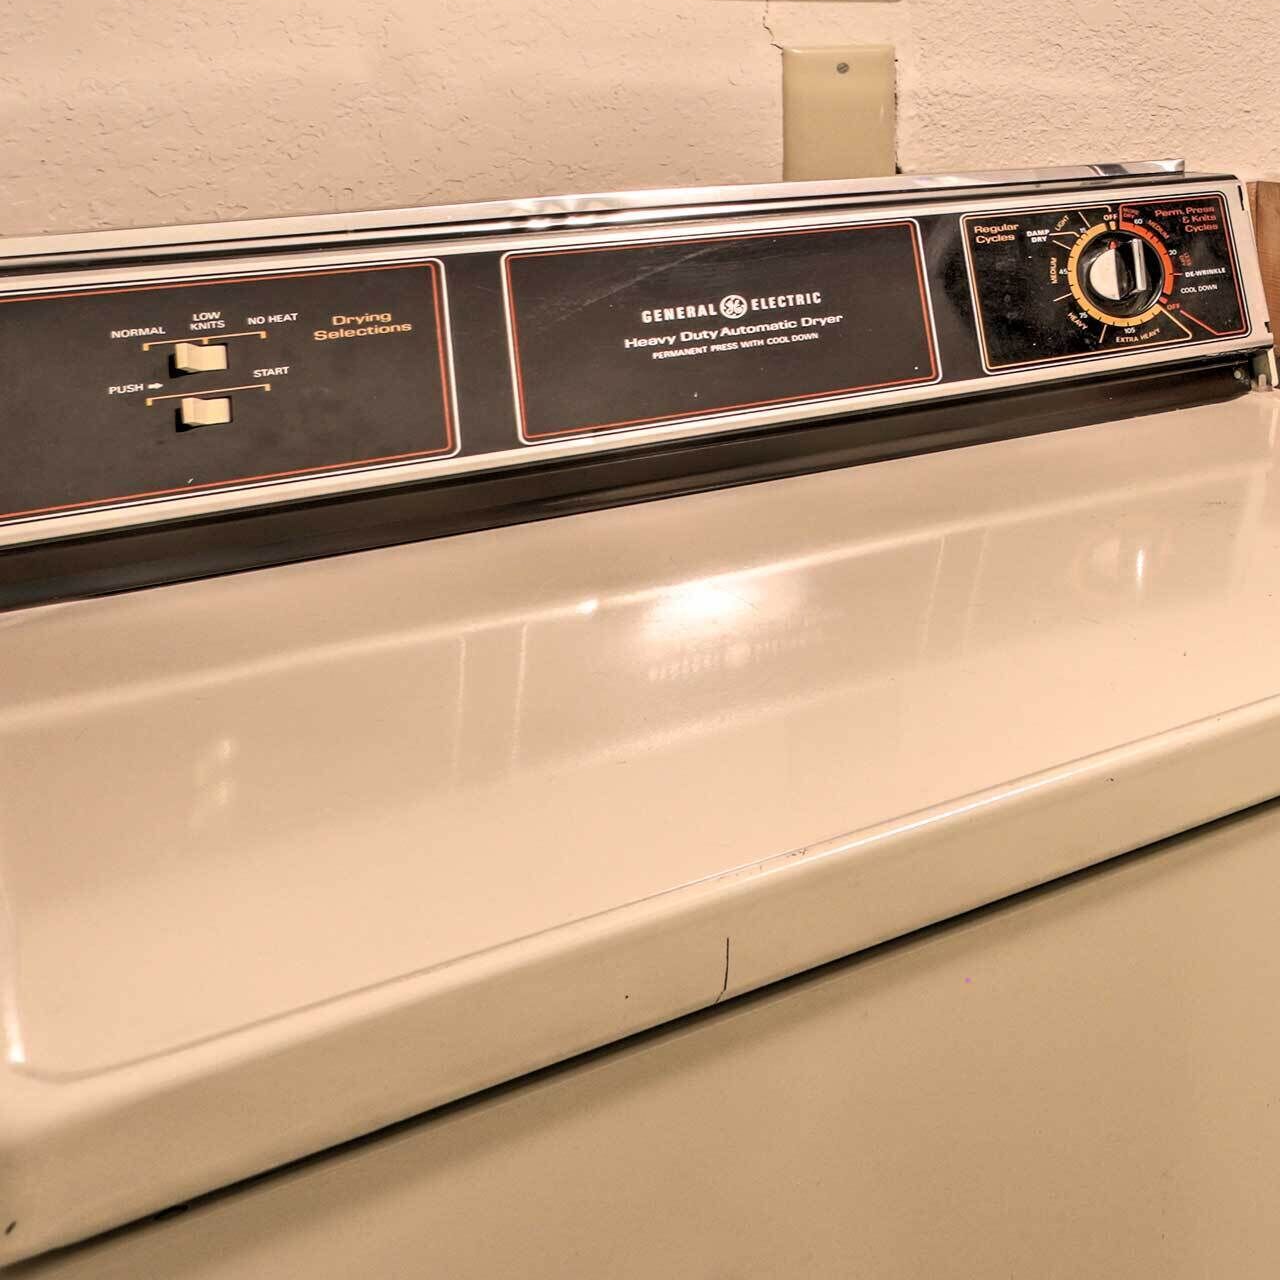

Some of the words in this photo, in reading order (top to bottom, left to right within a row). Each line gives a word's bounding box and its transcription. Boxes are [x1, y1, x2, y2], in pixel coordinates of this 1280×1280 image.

[1103, 213, 1118, 221] OFF
[1154, 209, 1185, 217] Perm.
[1186, 206, 1215, 214] Press
[974, 224, 1019, 234] Regular
[1055, 215, 1070, 232] LIGHT
[1148, 219, 1170, 239] MEDIUM
[1184, 223, 1218, 233] Cycles
[1026, 229, 1050, 237] DAMP
[976, 234, 1015, 244] Cycles
[1185, 267, 1226, 278] DE-WRINKLE
[1180, 286, 1198, 294] COOL
[1198, 284, 1218, 292] DOWN
[641, 303, 717, 323] GENERAL
[751, 291, 822, 311] ELECTRIC
[193, 311, 221, 321] LOW
[248, 316, 266, 325] NO
[269, 313, 298, 323] HEAT
[332, 312, 392, 327] Drying
[1067, 312, 1088, 330] HEAVY
[190, 320, 225, 331] KNITS
[314, 322, 412, 340] Selections
[111, 327, 166, 339] NORMAL
[624, 335, 676, 349] Heavy
[680, 329, 719, 342] Duty
[720, 319, 798, 337] Automatic
[800, 314, 843, 327] Dryer
[1140, 328, 1160, 339] HEAVY
[652, 345, 707, 360] PERMANENT
[711, 341, 738, 353] PRESS
[740, 338, 764, 349] WITH
[766, 335, 790, 346] COOL
[792, 332, 819, 342] DOWN
[253, 367, 290, 378] START
[108, 383, 144, 395] PUSH
